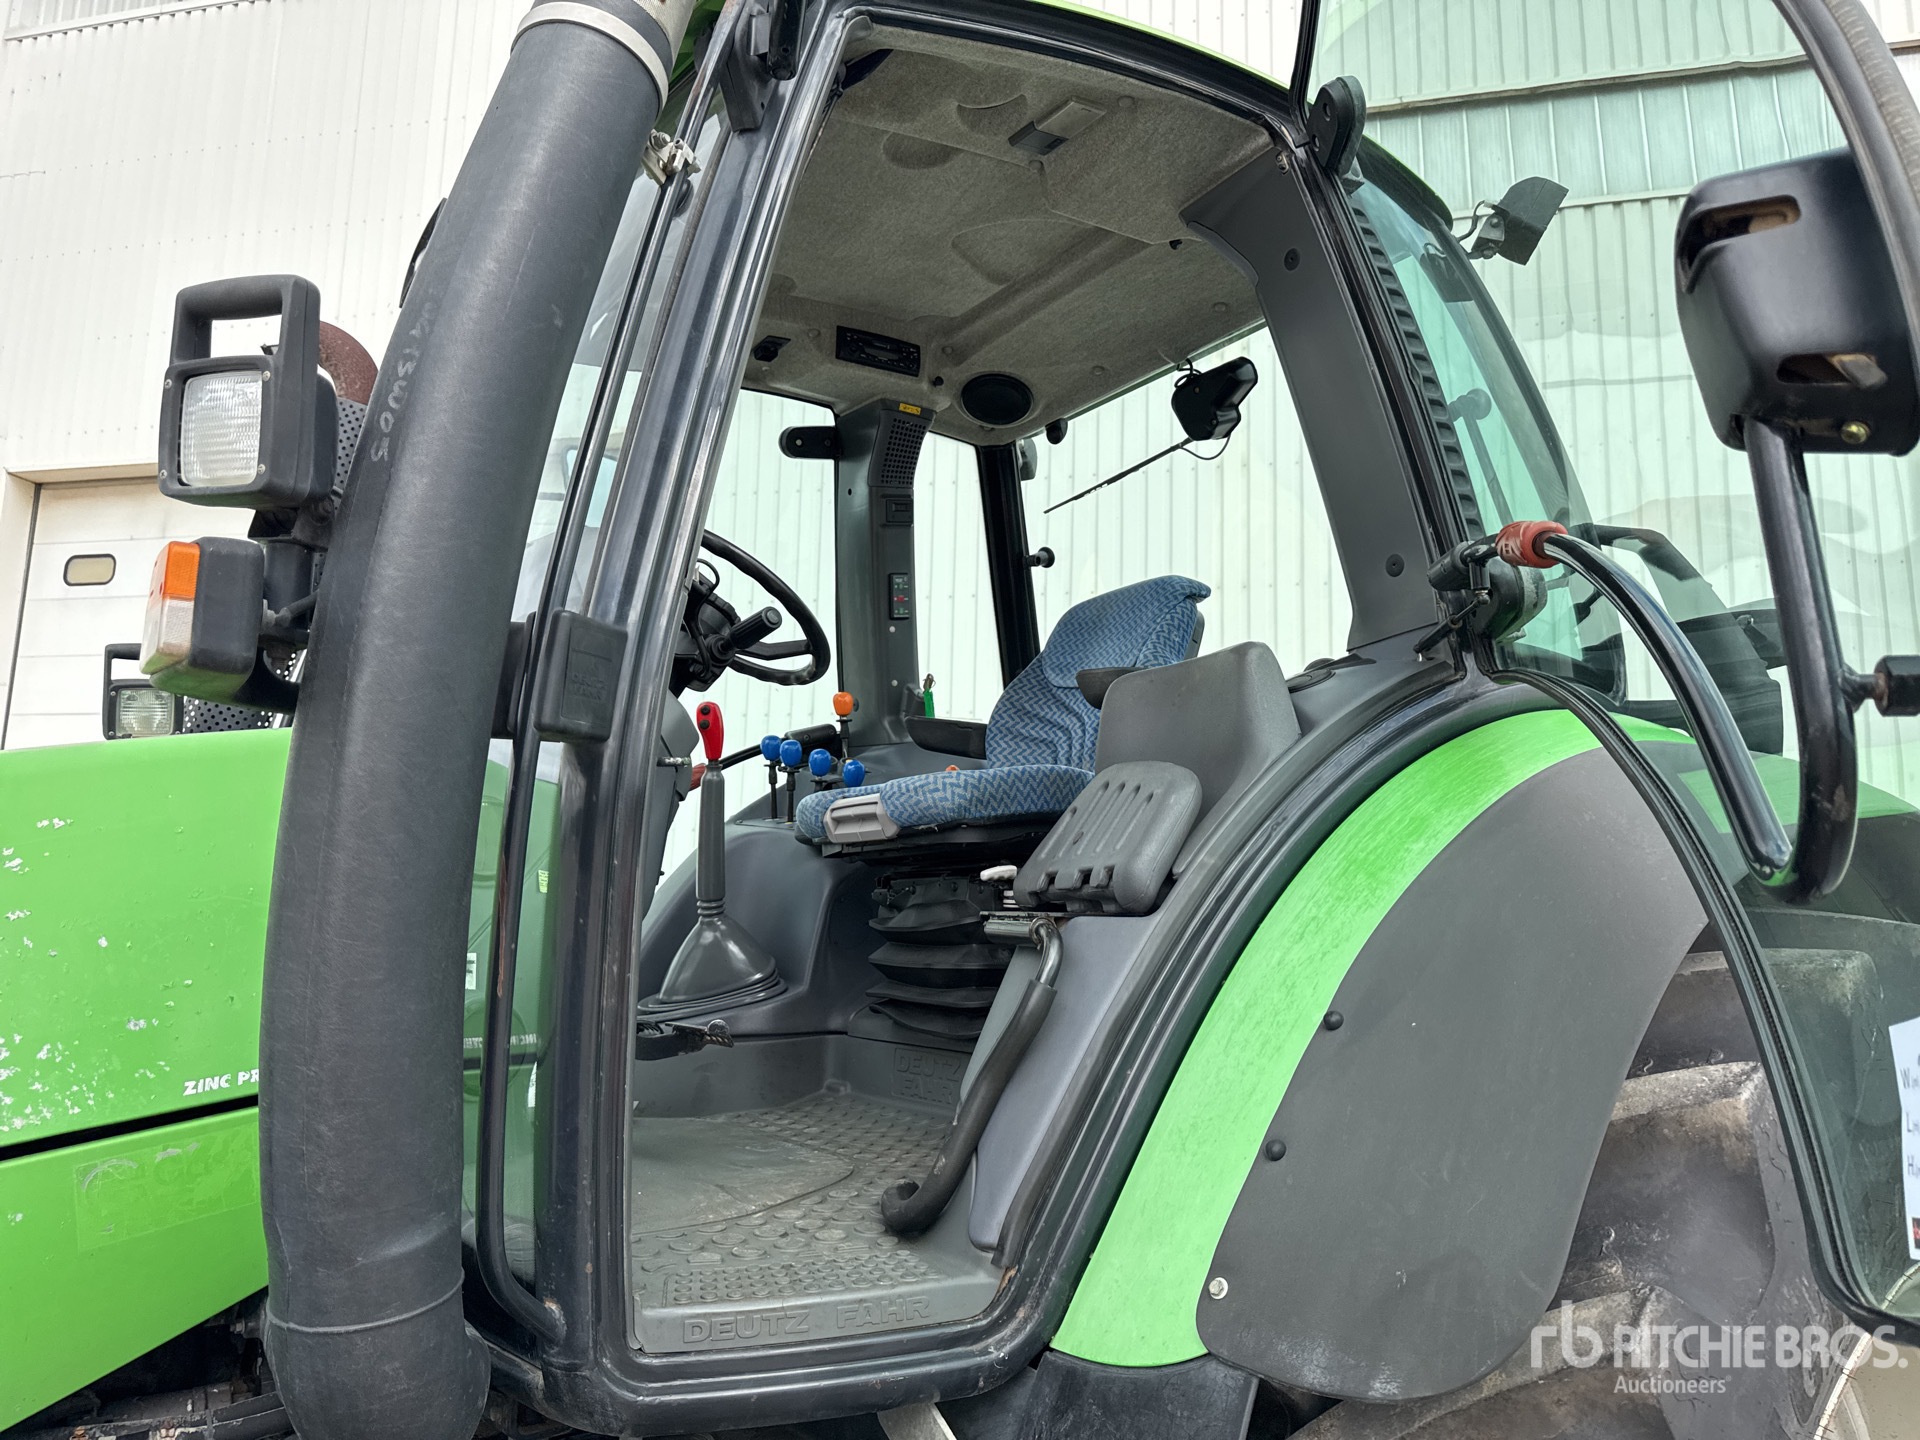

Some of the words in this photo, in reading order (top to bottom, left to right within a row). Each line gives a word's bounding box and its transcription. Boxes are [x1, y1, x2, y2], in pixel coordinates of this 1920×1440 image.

[897, 1056, 962, 1083] DEUTZ
[183, 1073, 231, 1096] ZINC
[902, 1079, 953, 1105] FAHR
[683, 1310, 810, 1343] DEUTZ
[836, 1295, 930, 1329] FAHR
